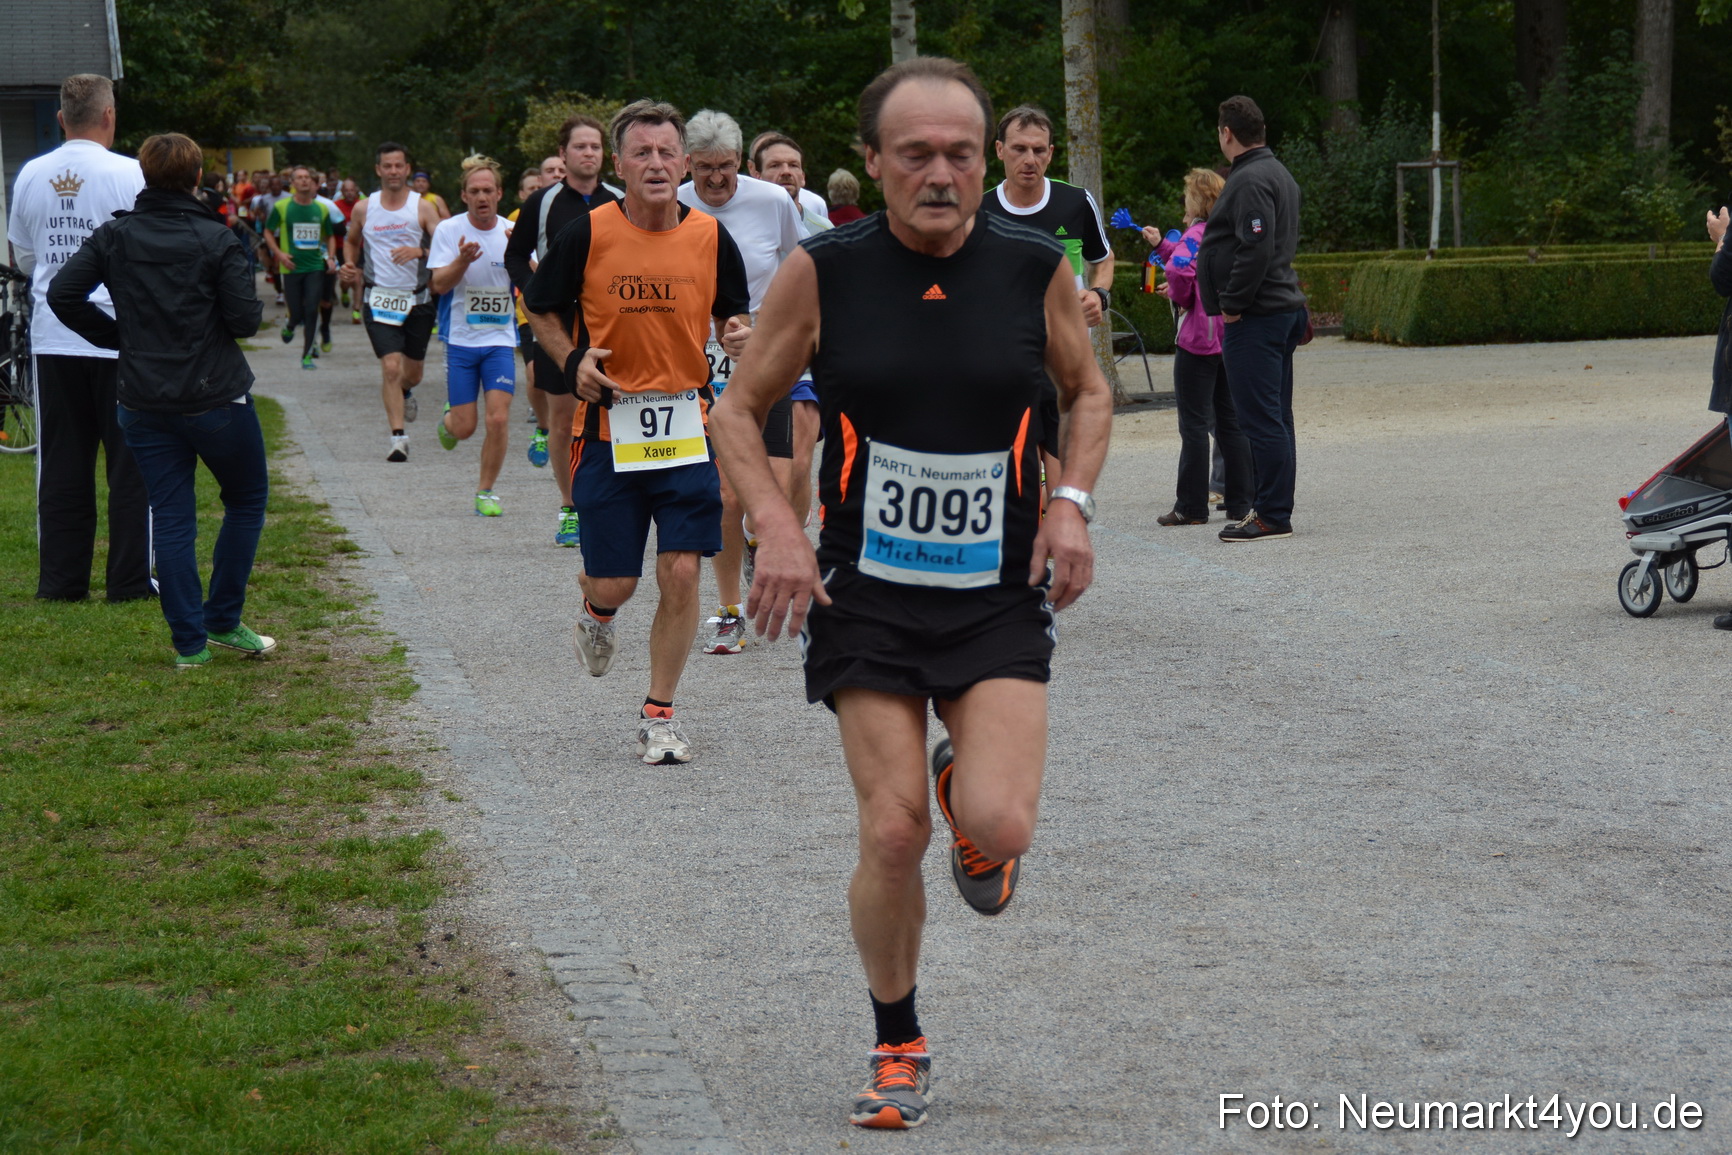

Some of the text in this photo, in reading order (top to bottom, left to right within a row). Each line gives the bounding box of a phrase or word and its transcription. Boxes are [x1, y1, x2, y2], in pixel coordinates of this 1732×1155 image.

[61, 199, 74, 211] IM
[296, 229, 319, 240] 2315
[619, 283, 677, 301] OEXL
[372, 295, 408, 312] 2800
[470, 296, 510, 313] 2557
[619, 306, 641, 314] CIBA
[615, 393, 684, 406] ARTL Neumarkt
[639, 405, 674, 438] 97
[643, 446, 677, 459] Xaver
[873, 455, 987, 481] PARTL Neumarkt
[879, 479, 993, 536] 3093
[876, 535, 966, 566] Michael
